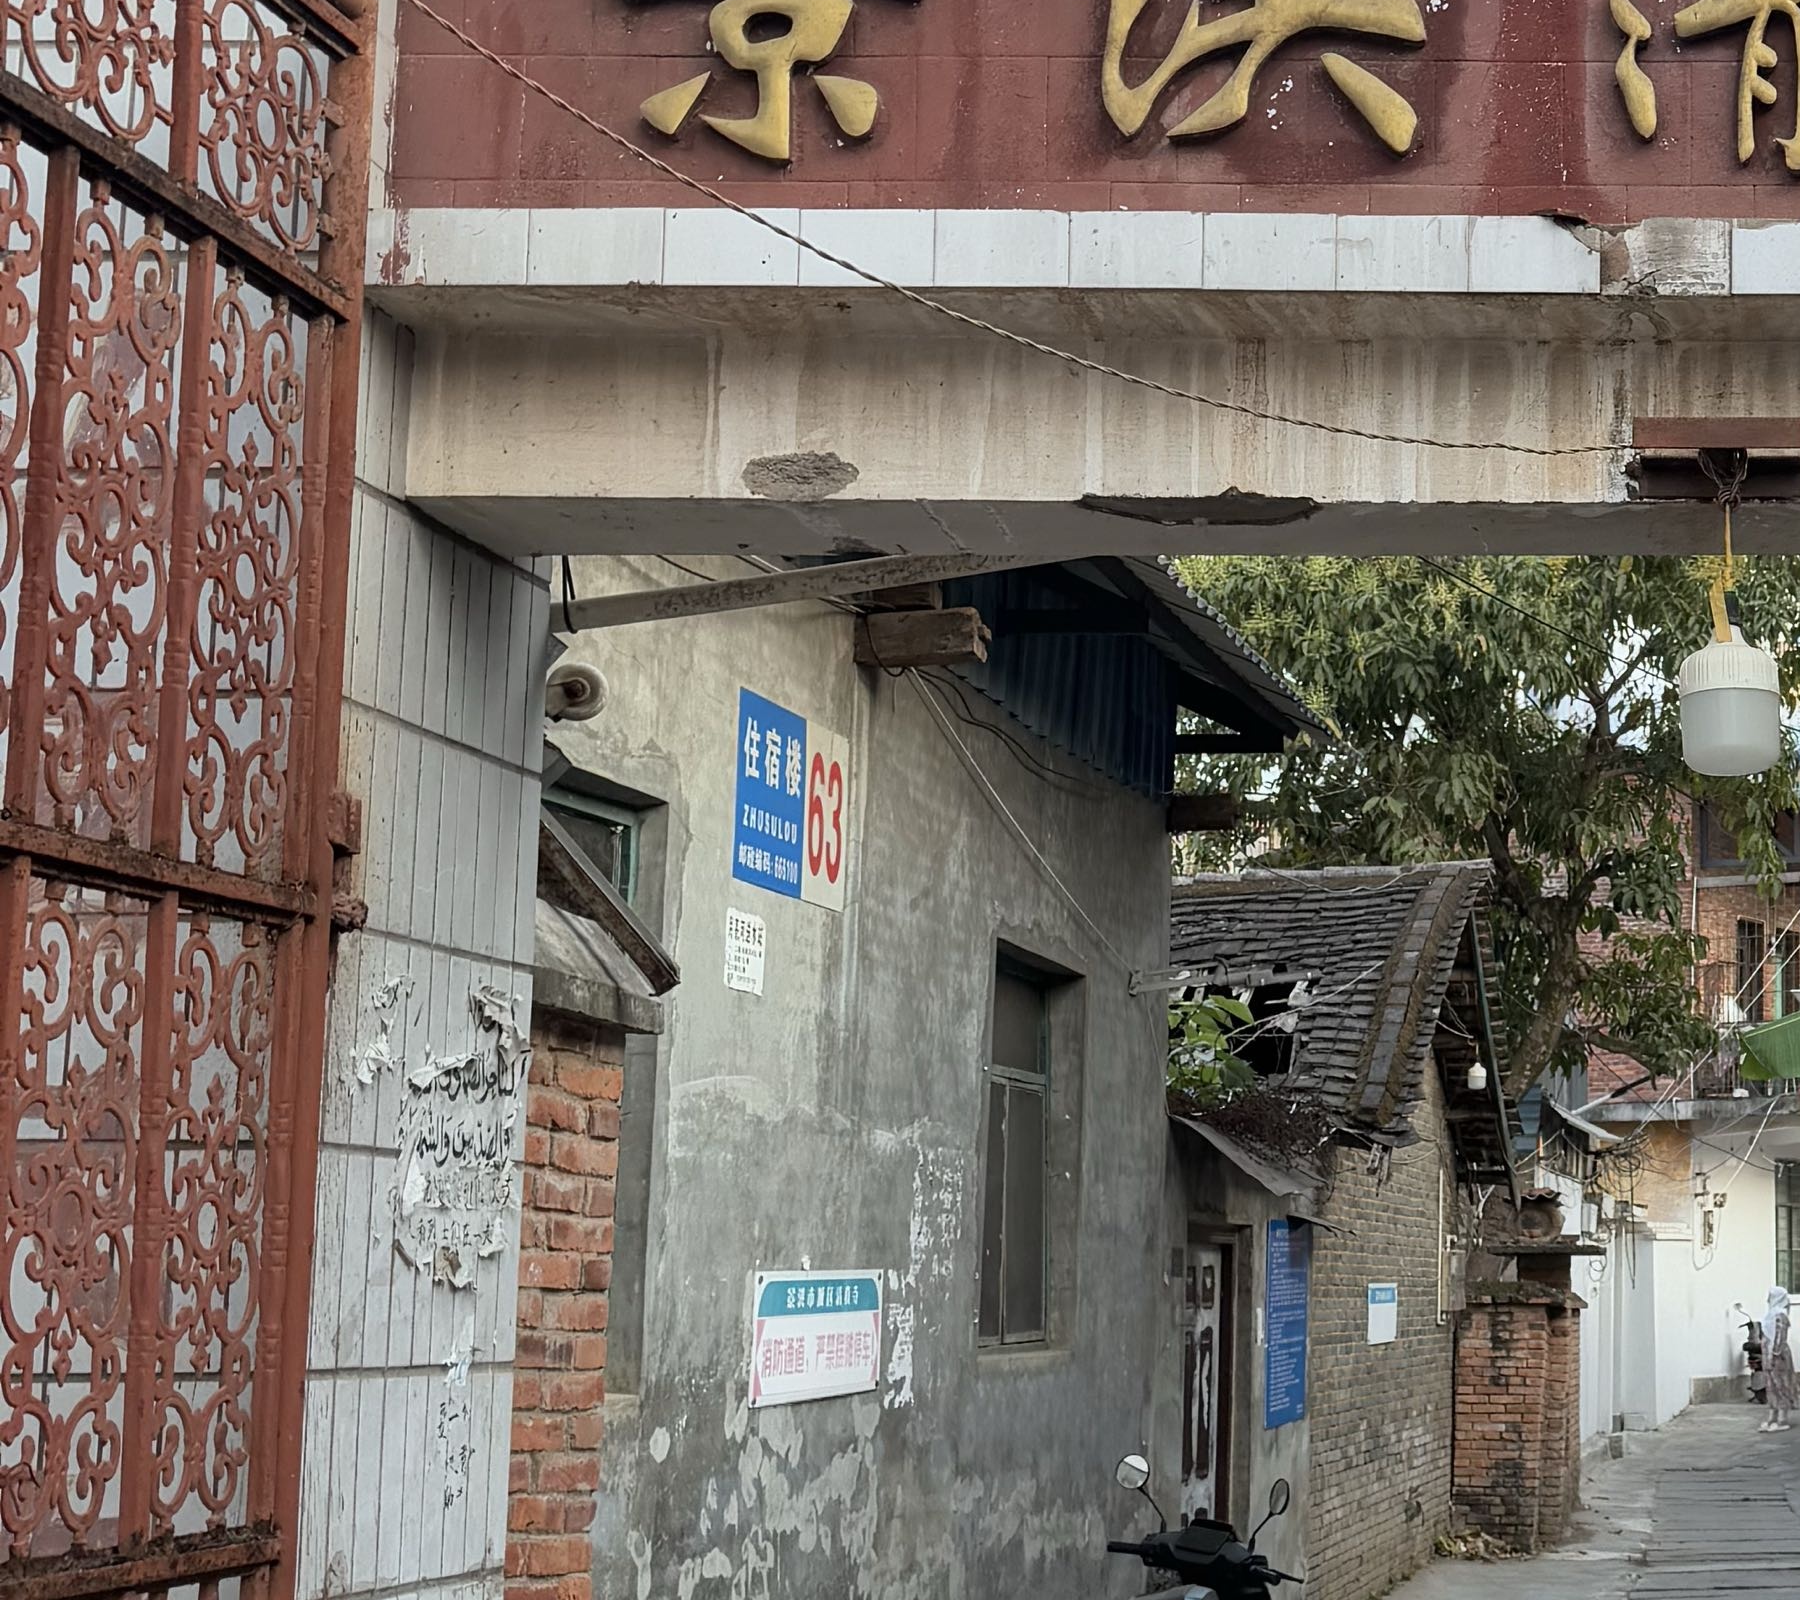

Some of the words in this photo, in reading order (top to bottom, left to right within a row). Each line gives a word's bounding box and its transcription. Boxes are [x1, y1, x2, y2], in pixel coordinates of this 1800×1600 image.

[744, 716, 802, 799] 住宿楼
[742, 803, 798, 845] ZHUSULOU
[807, 751, 843, 884] 63
